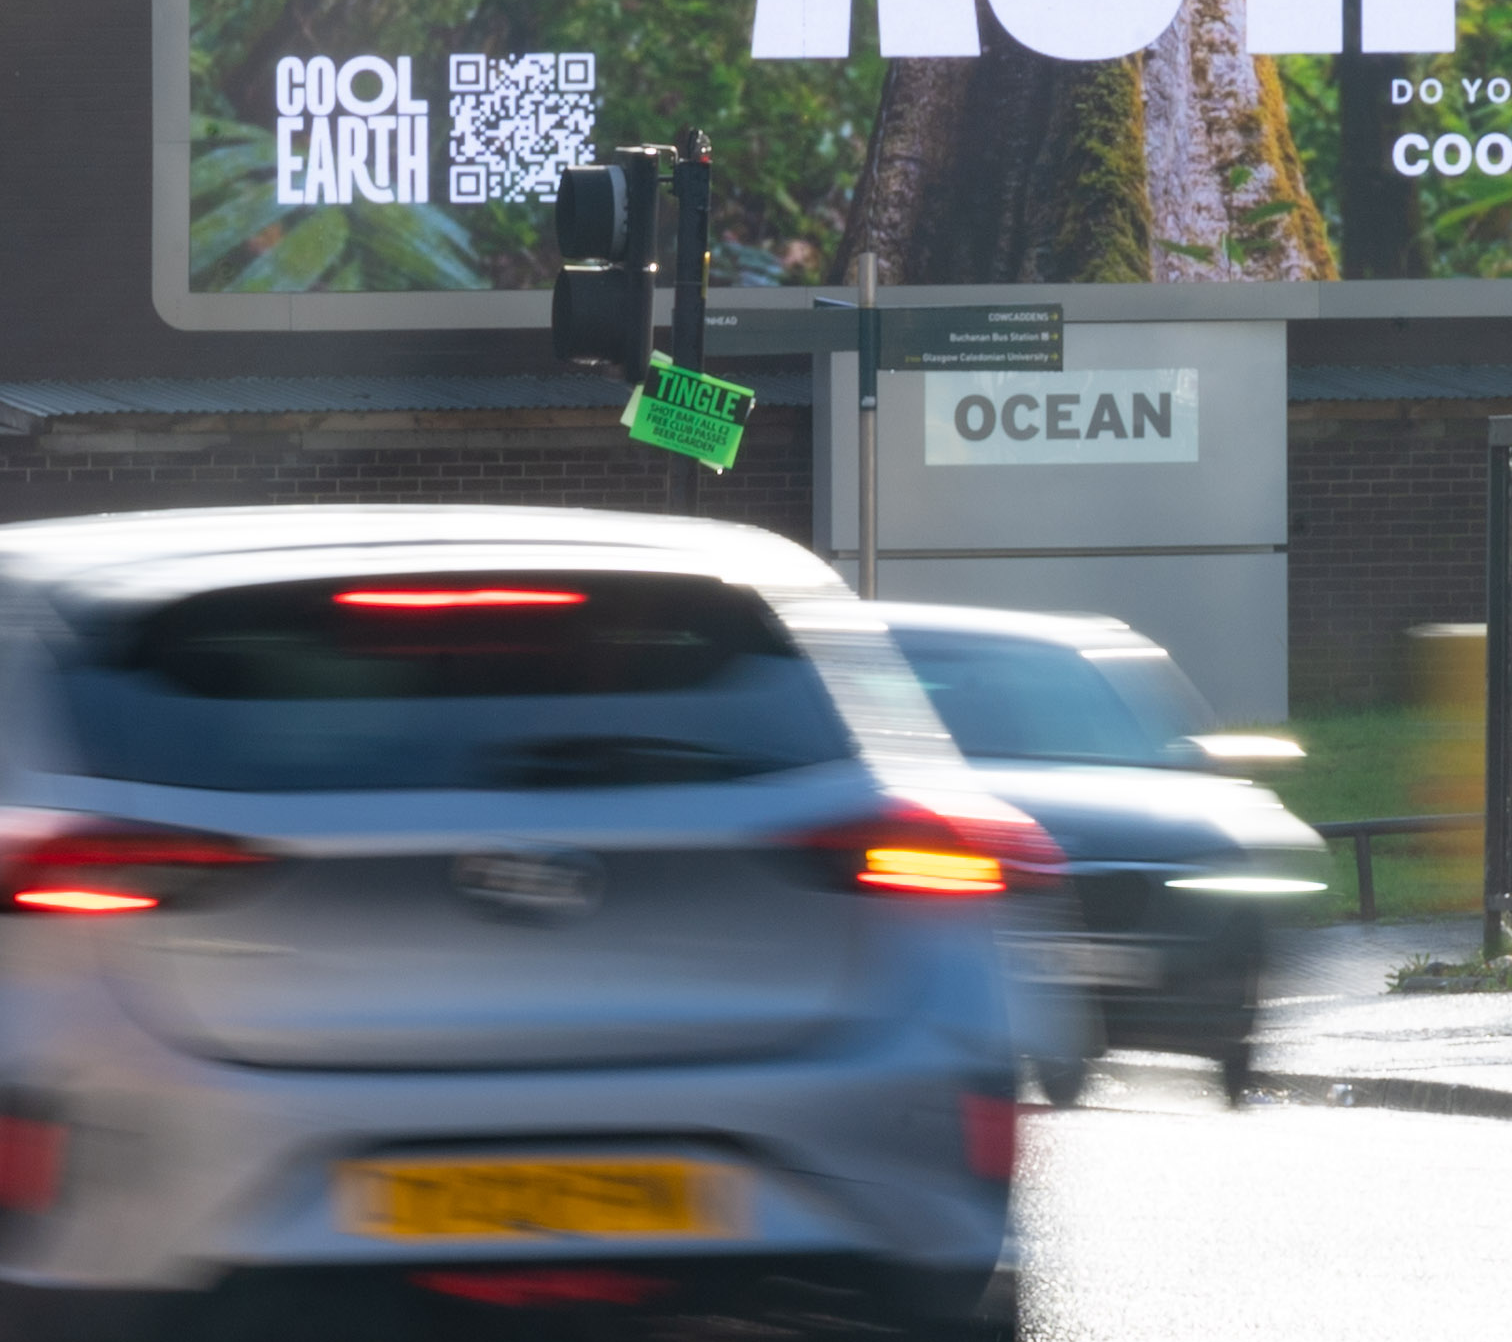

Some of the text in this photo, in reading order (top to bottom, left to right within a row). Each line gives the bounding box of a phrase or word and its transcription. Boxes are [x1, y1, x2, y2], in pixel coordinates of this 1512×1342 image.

[277, 54, 428, 116] COOL
[1391, 77, 1444, 104] DO
[277, 115, 428, 204] EARTH
[704, 315, 738, 326] NHEAD
[988, 312, 1049, 323] COWCADDENS
[949, 332, 1039, 343] Buchanan Bus Station
[922, 352, 958, 364] Glasgow
[959, 352, 1006, 362] Caledonian
[1007, 351, 1049, 363] University
[657, 369, 741, 421] TINGLE
[647, 413, 727, 446] FREE CLUB PASSES
[651, 403, 674, 418] SHOT
[677, 410, 695, 423] BAR
[700, 418, 716, 431] ALL
[954, 392, 1171, 441] OCEAN
[653, 426, 676, 440] BEER
[678, 434, 716, 453] GARDEN
